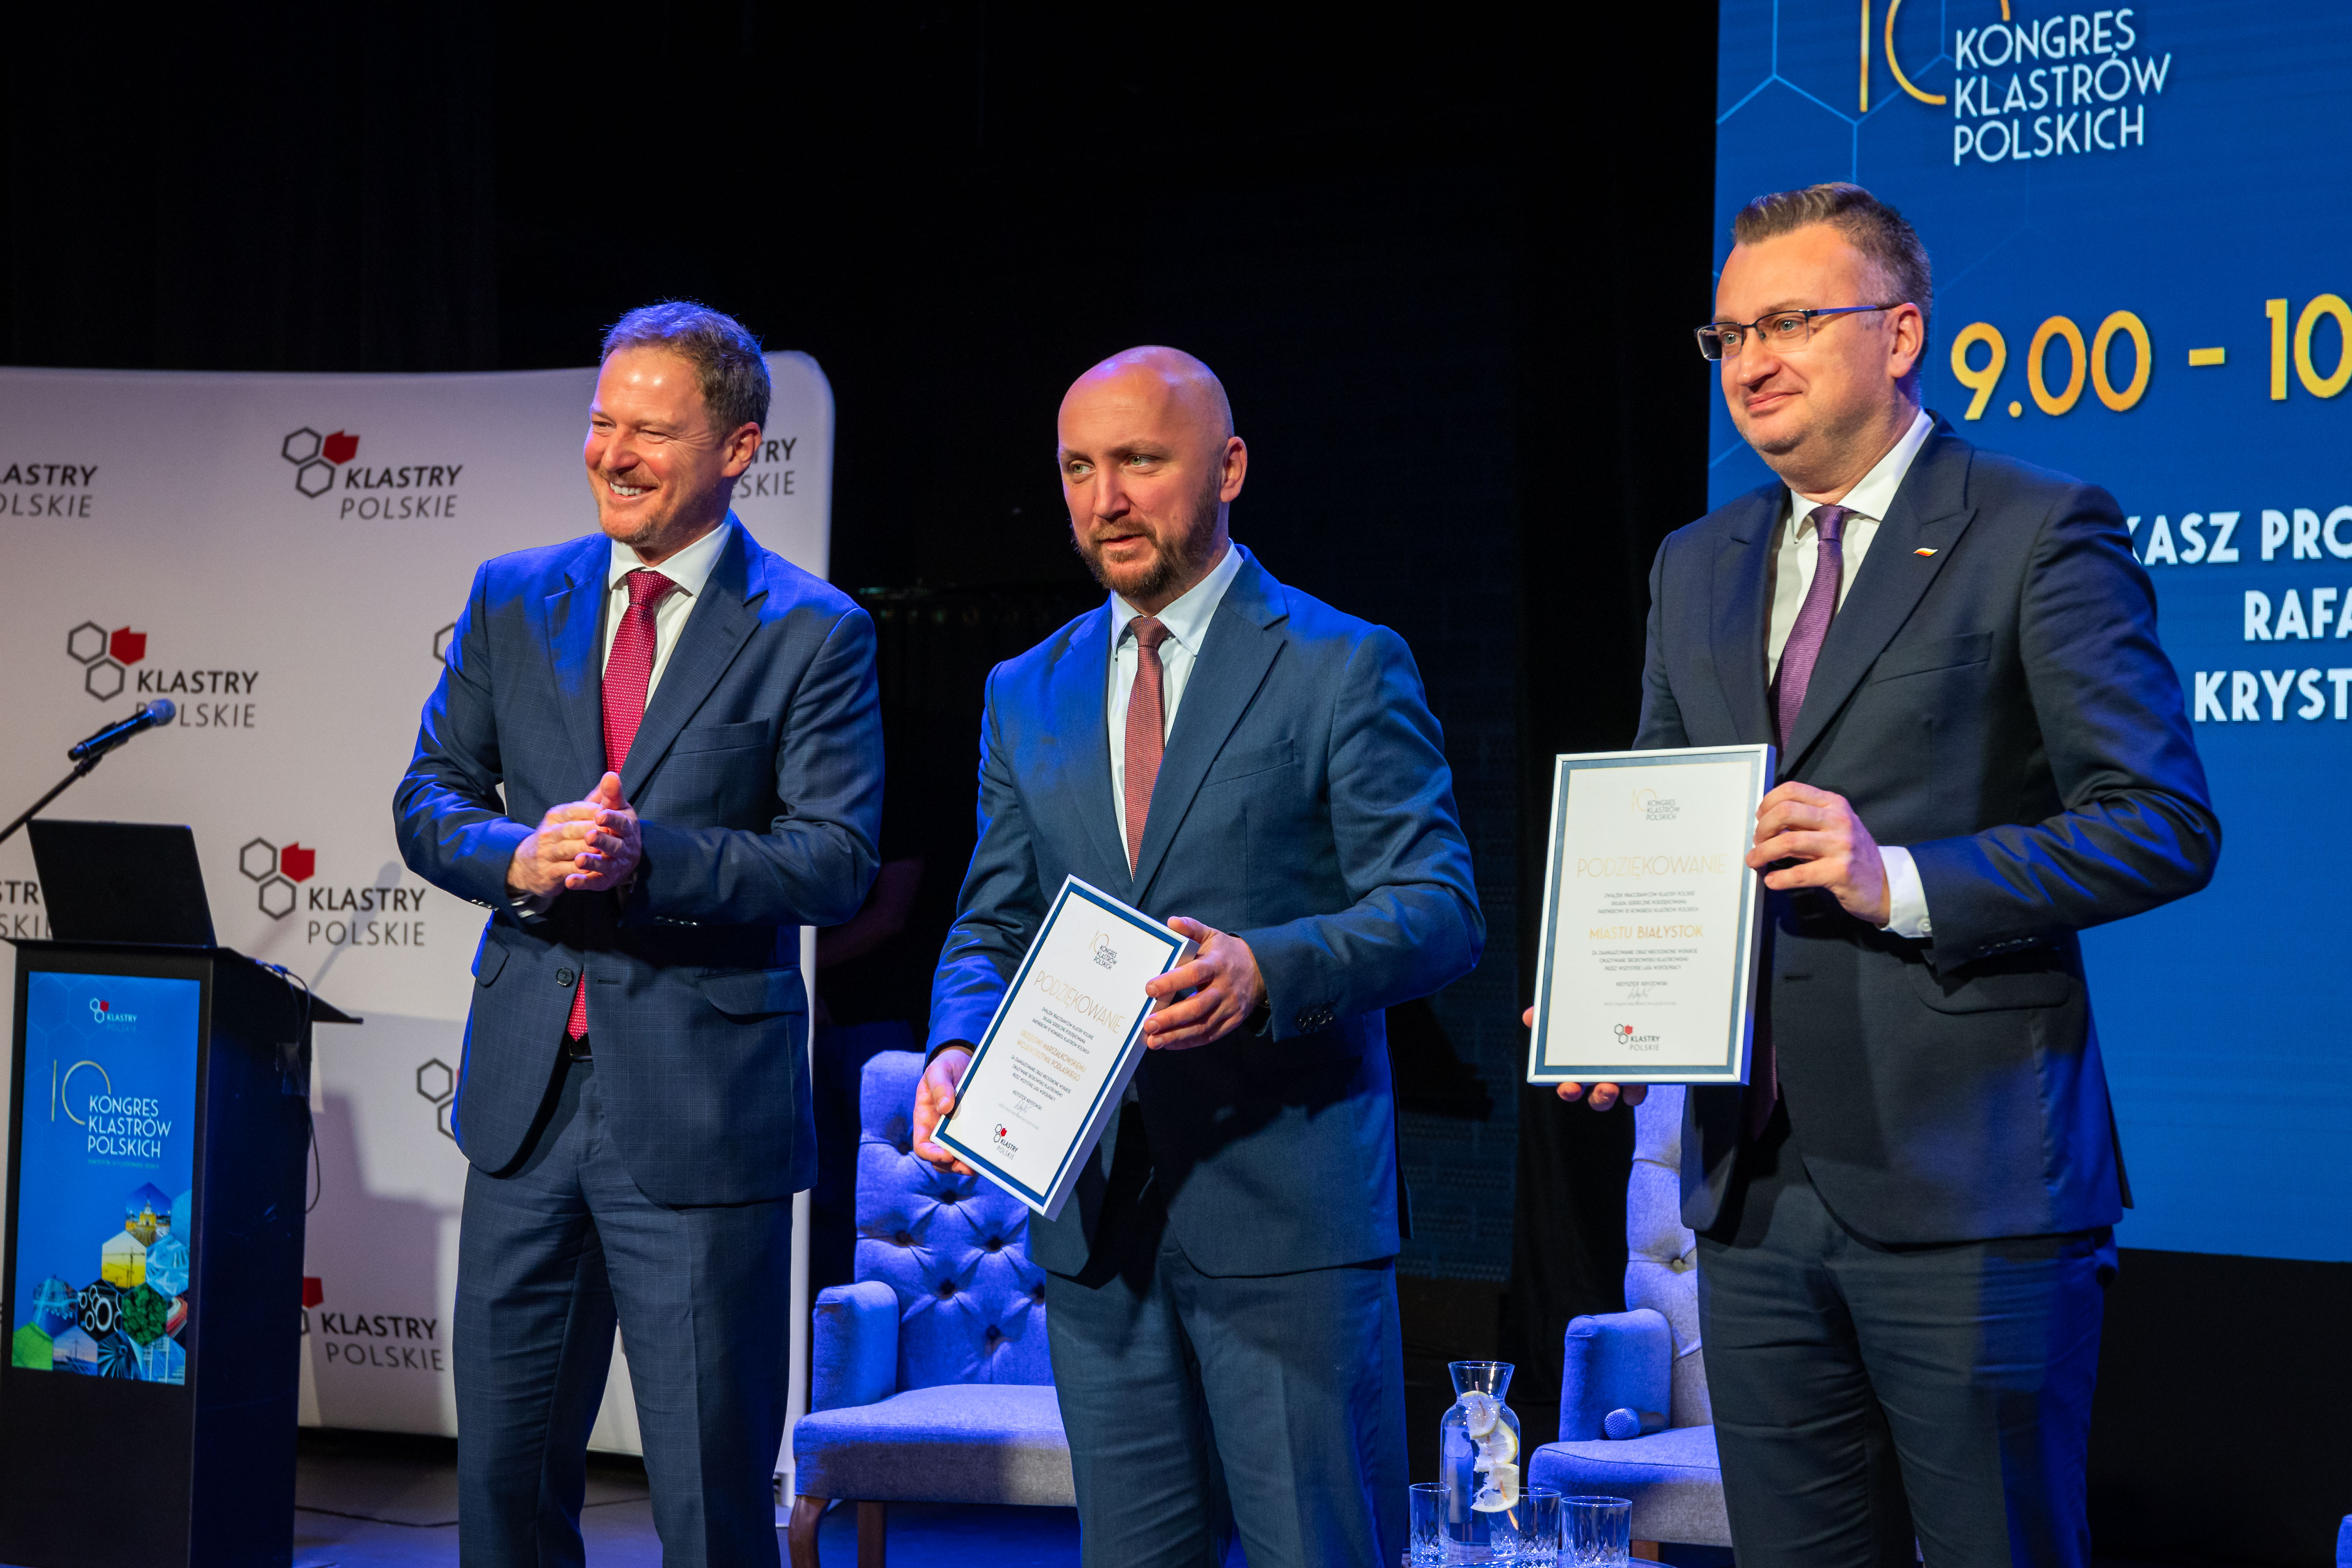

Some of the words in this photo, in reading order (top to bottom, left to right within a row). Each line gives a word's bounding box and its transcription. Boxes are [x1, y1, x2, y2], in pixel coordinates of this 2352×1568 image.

[1955, 8, 2136, 71] KONGRES
[1954, 51, 2172, 119] KLASTRÓW
[1954, 104, 2144, 166] POLSKICH
[1950, 309, 2151, 421] 9.00
[0, 463, 98, 486] ASTRY
[345, 464, 463, 490] KLASTRY
[732, 470, 795, 499] SKIE
[340, 495, 458, 520] POLSKIE
[137, 669, 259, 694] KLASTRY
[2194, 668, 2352, 722] KRYST
[1577, 854, 1728, 879] PODZIĘKOWANIE
[309, 887, 426, 912] KLASTRY
[307, 921, 425, 947] POLSKIE
[1589, 925, 1633, 939] MIASTU
[1637, 924, 1703, 939] BIAŁYSTOK
[1093, 956, 1112, 970] POLSKICH
[1099, 944, 1118, 958] KONGRES
[1034, 971, 1125, 1033] PODZIĘKOWANIE
[107, 1013, 137, 1023] KLASTRY
[89, 1095, 158, 1117] KONGRES
[88, 1116, 171, 1138] KLASTRÓW
[88, 1135, 160, 1158] POLSKICH
[996, 1145, 1015, 1160] POLSKIE
[1000, 1139, 1018, 1152] KLASTRY
[321, 1312, 437, 1340] KLASTRY
[326, 1342, 444, 1371] POLSKIE
